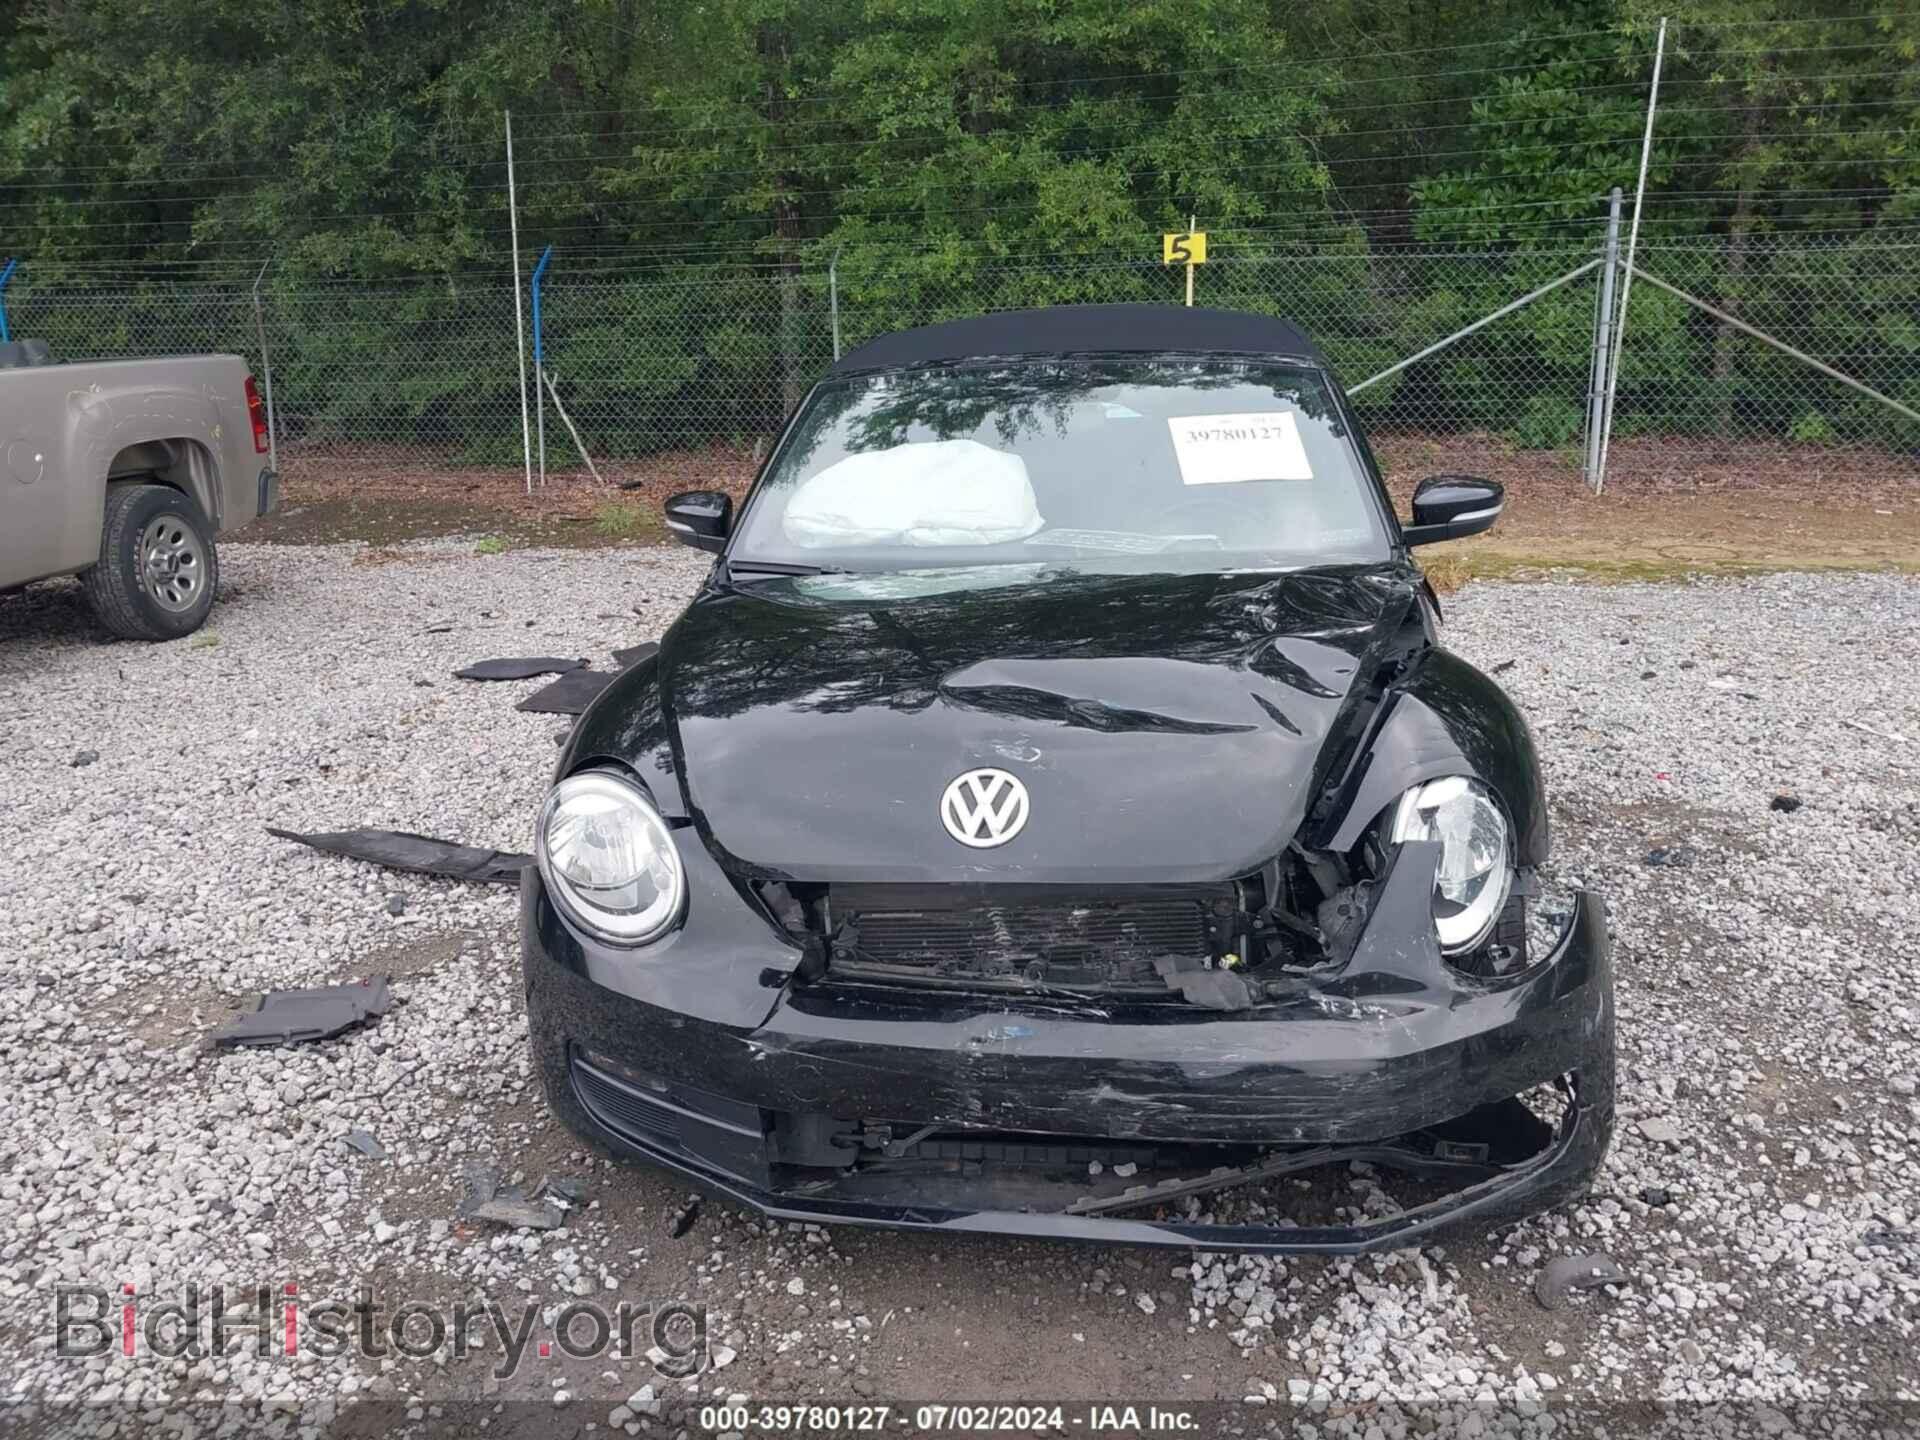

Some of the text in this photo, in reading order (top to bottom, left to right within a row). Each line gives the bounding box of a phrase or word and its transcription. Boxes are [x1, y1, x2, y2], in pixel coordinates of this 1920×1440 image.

[1169, 234, 1192, 264] 5
[1185, 426, 1283, 442] 39780127
[941, 767, 1030, 848] VW
